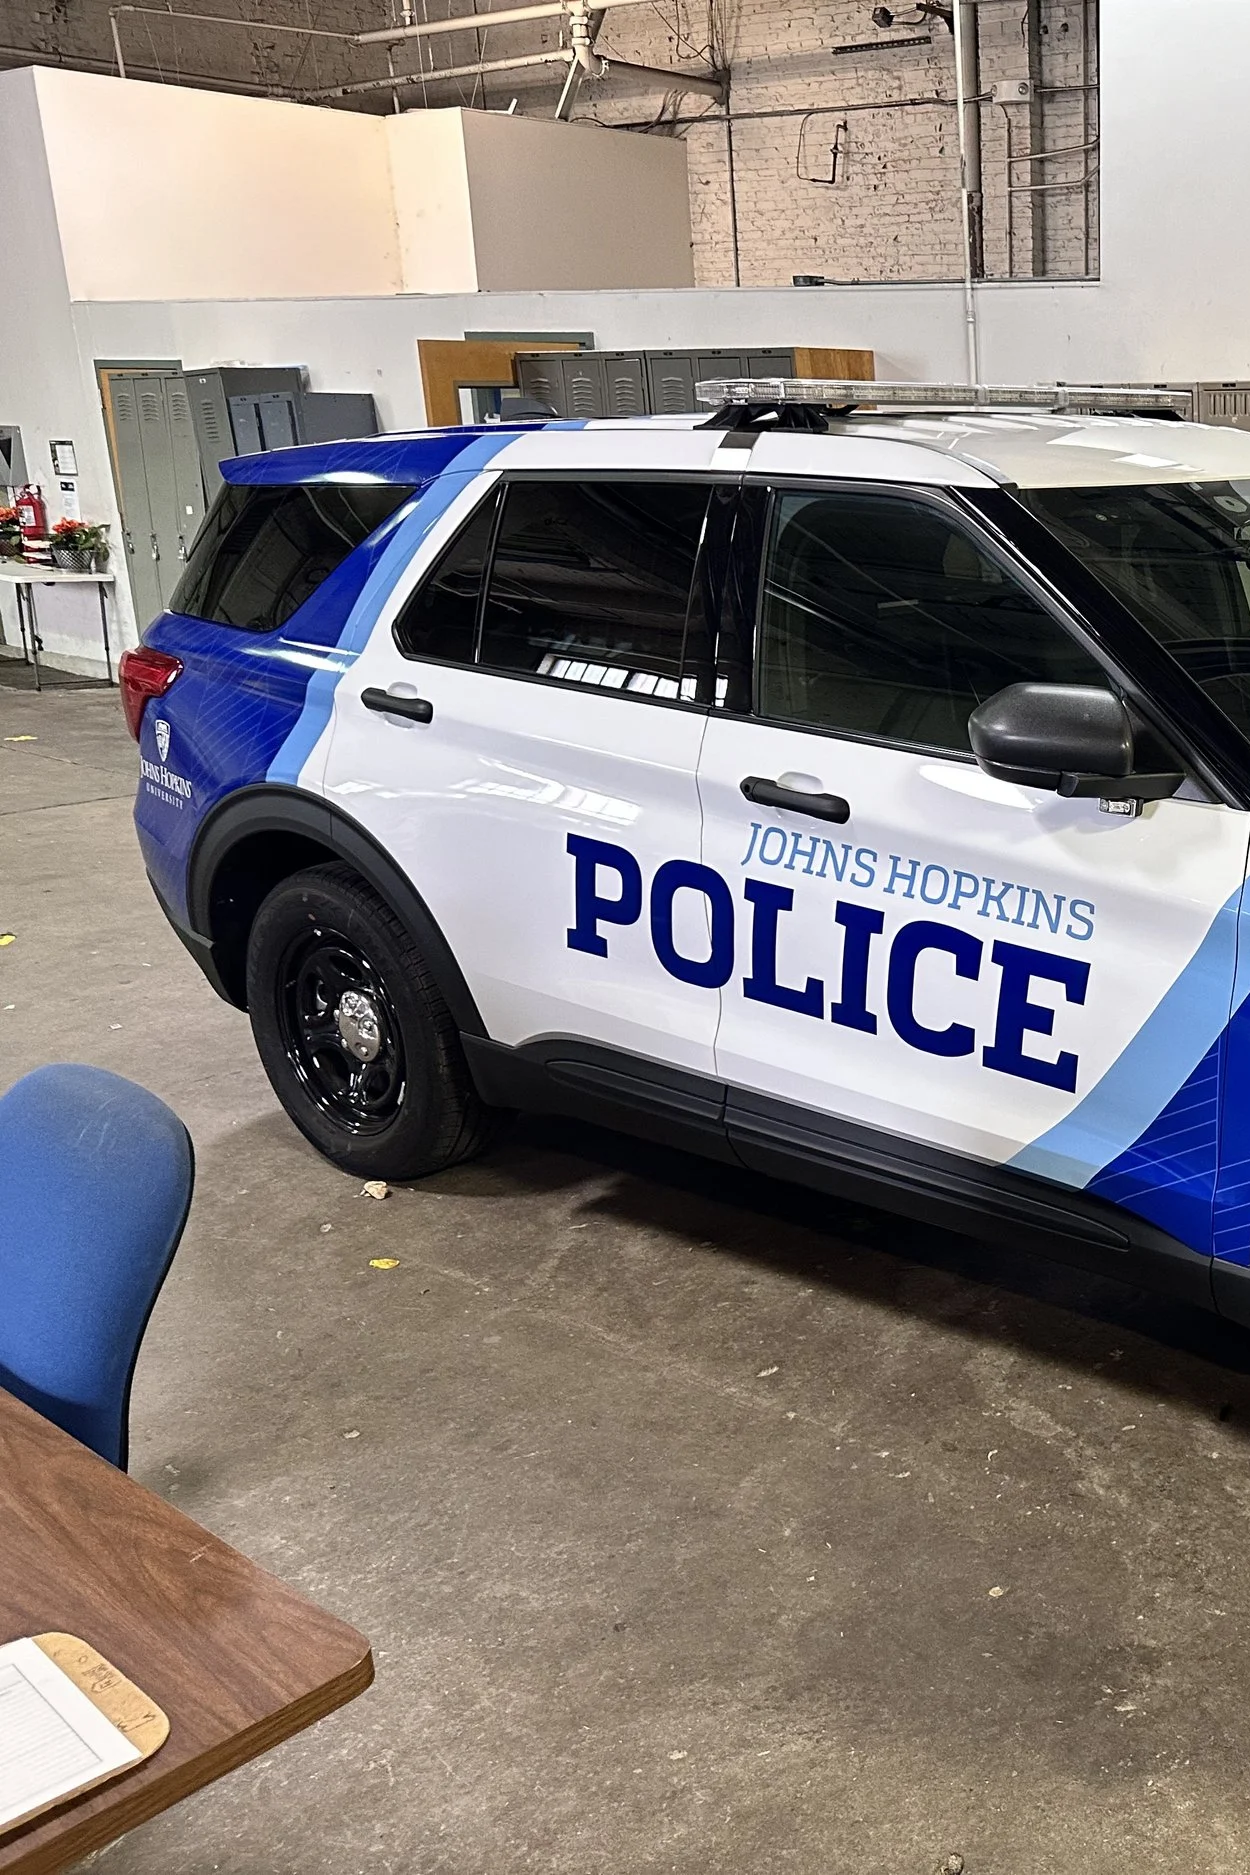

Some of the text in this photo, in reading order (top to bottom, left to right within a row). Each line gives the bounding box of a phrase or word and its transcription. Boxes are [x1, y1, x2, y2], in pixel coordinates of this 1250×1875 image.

[145, 782, 184, 810] UNIVERSITY
[159, 765, 192, 799] HOPKINS
[740, 822, 1096, 941] JOHNS HOPKINS
[566, 832, 1091, 1094] POLICE
